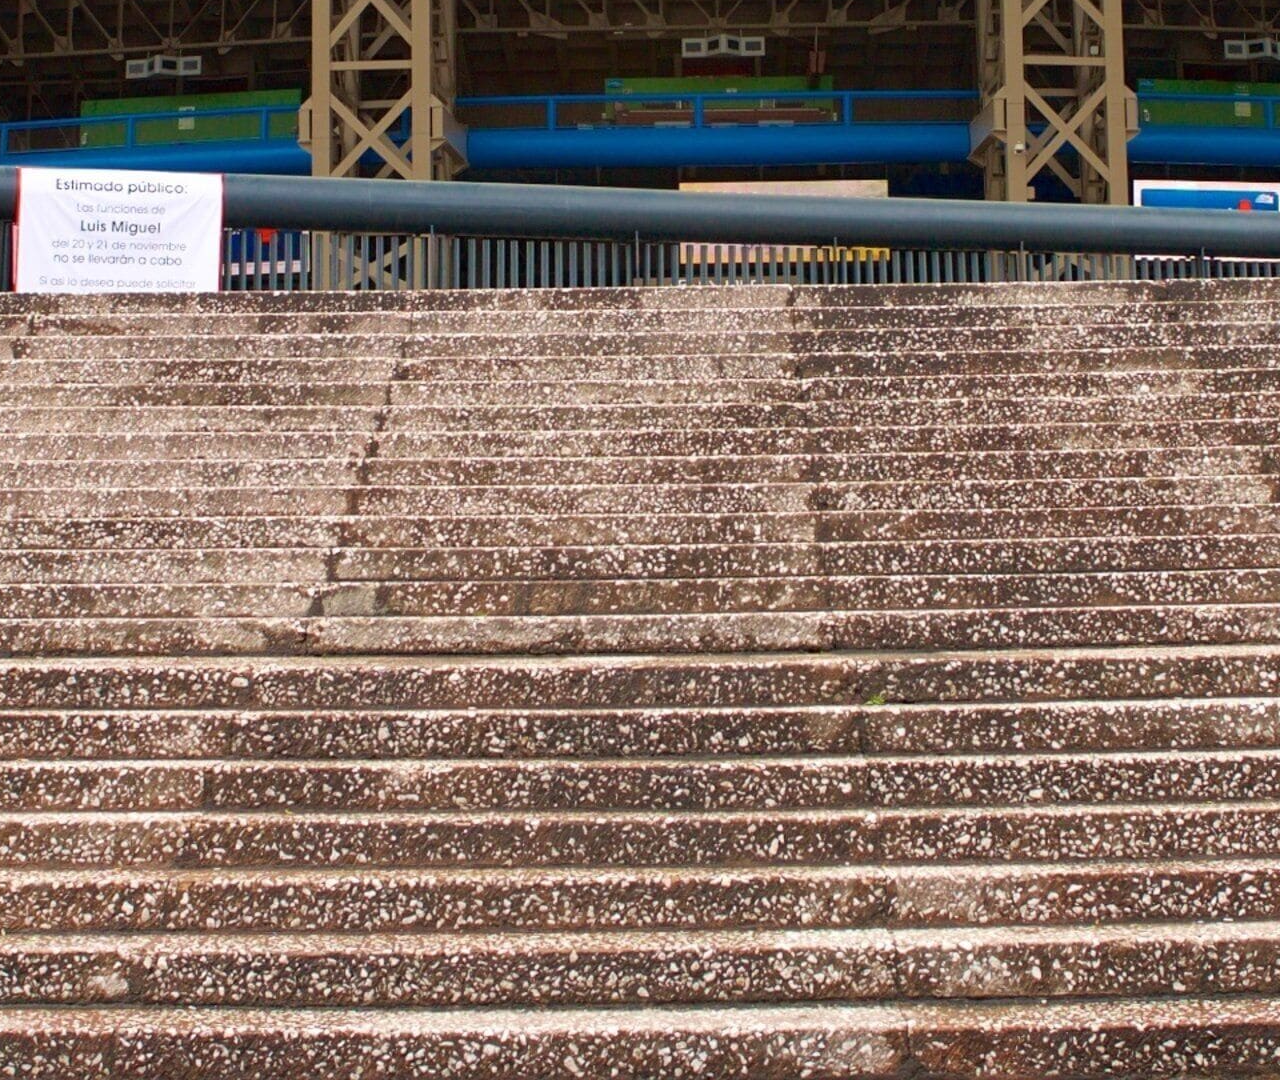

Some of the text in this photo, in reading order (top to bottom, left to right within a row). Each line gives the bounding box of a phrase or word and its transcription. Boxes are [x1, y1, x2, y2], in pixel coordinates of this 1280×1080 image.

[56, 178, 188, 195] Estimado público:
[76, 203, 166, 215] Las funciones de
[80, 219, 161, 236] Luis Miguel
[52, 238, 187, 251] del 20 y 21 de noviembre
[53, 252, 183, 266] no se llevarán a cabo
[39, 275, 48, 285] Si
[67, 276, 77, 287] lo
[80, 277, 114, 288] desea
[117, 278, 153, 289] puede
[155, 279, 196, 289] solicitar
